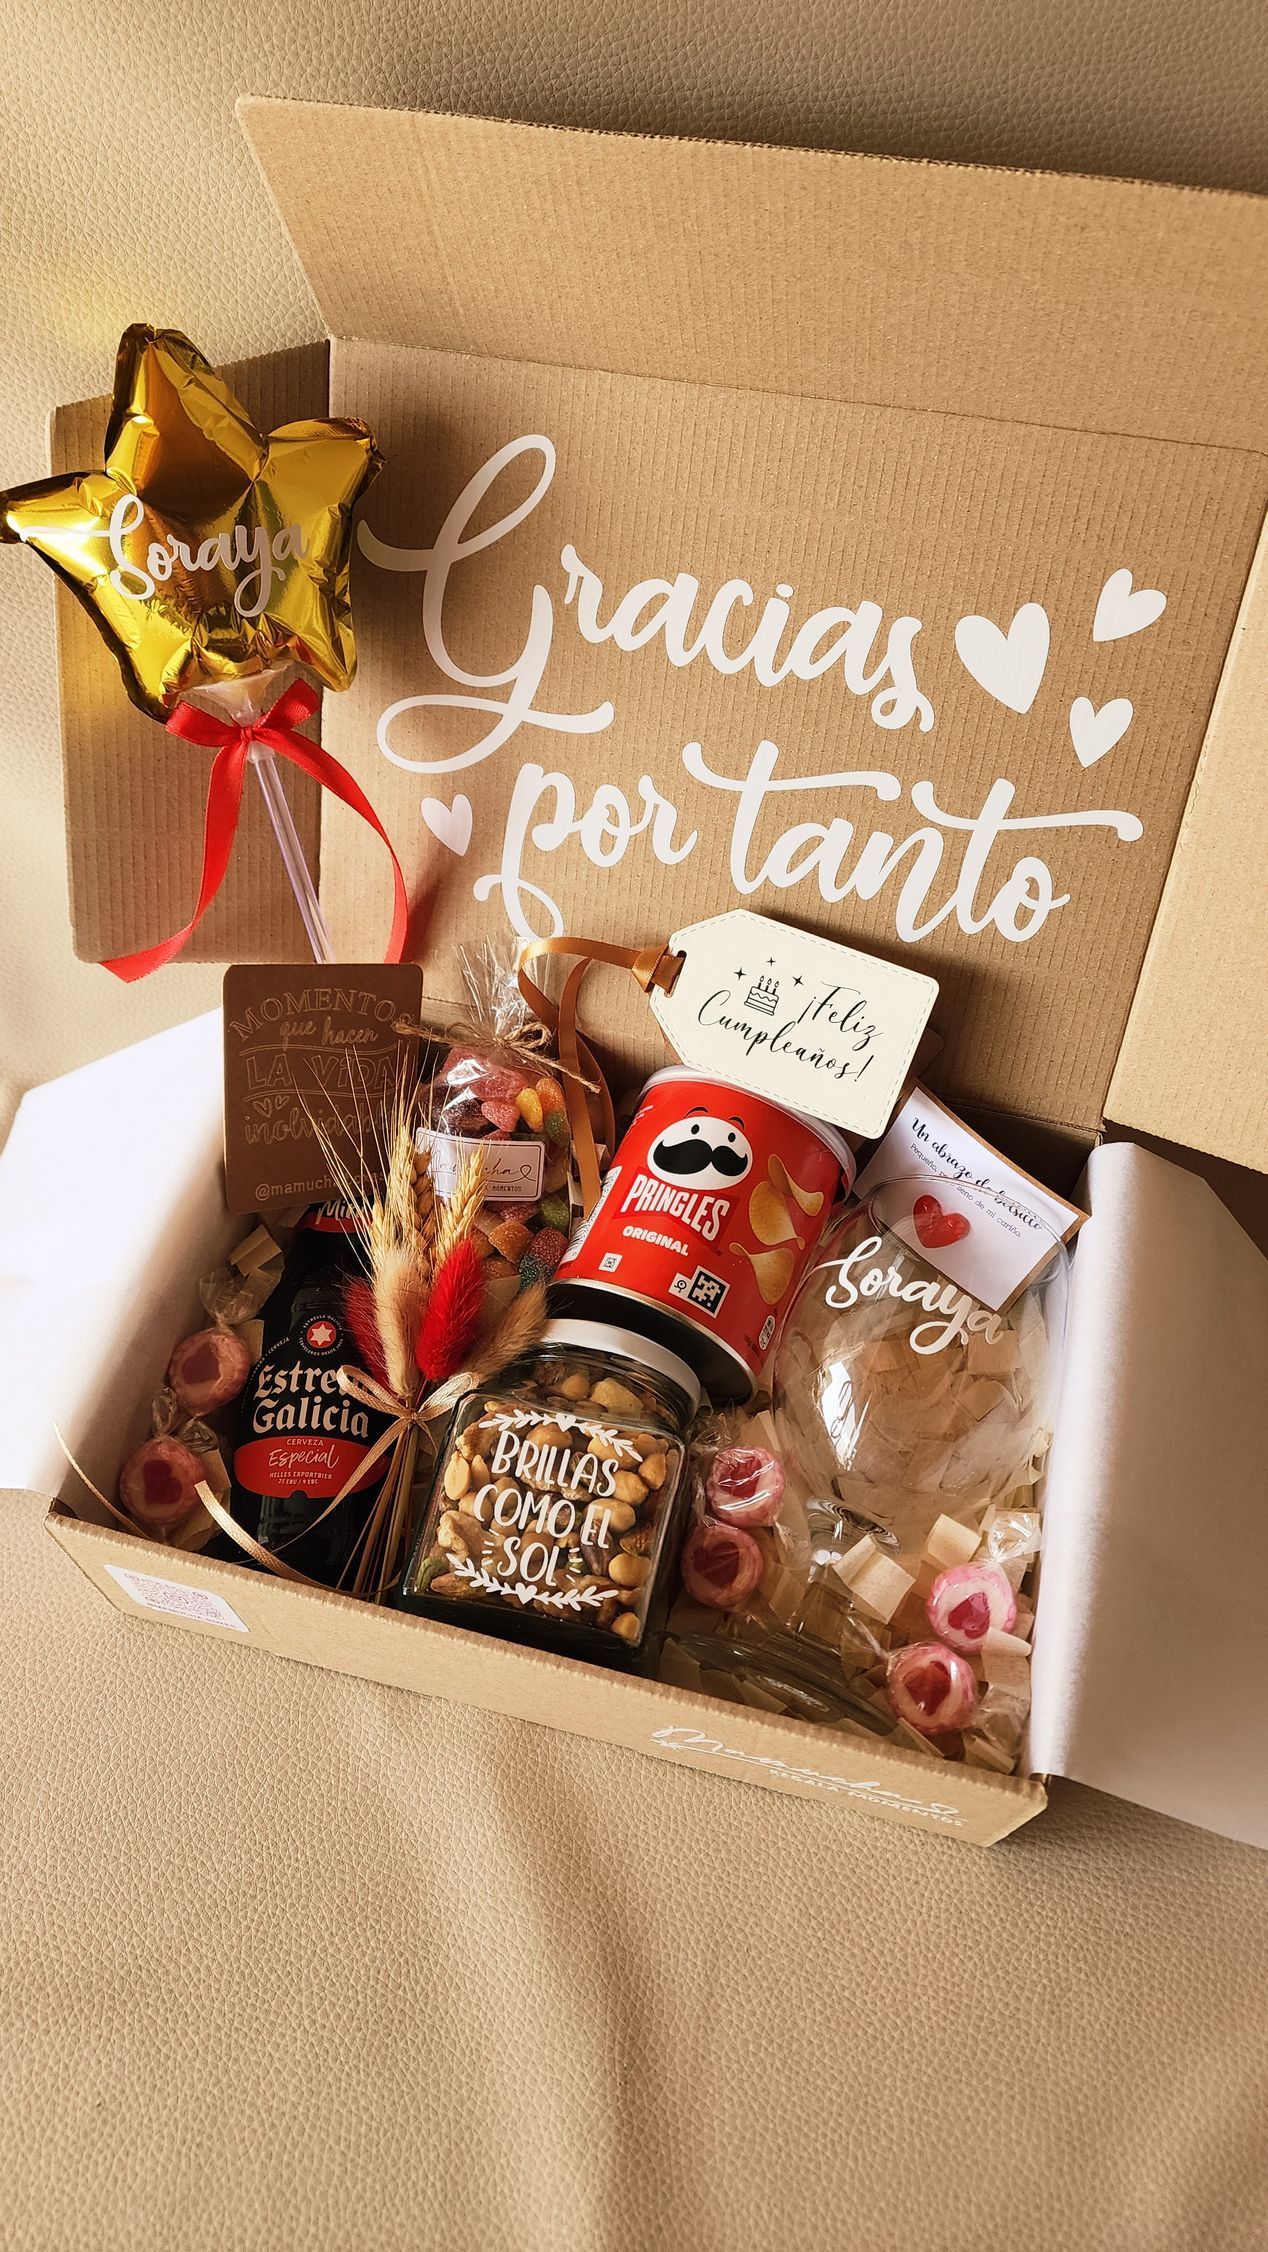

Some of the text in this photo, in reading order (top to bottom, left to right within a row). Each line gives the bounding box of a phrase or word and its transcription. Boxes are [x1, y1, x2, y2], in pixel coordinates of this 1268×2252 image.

[20, 494, 310, 618] Soraya
[356, 433, 936, 774] Gracias
[473, 740, 1145, 943] por tanto
[280, 1016, 378, 1051] que hacen
[697, 989, 875, 1082] Cumpleaños!
[797, 980, 884, 1052] ¡Feliz
[246, 1053, 293, 1090] LA
[912, 1117, 929, 1142] Un
[932, 1143, 973, 1179] abrazo
[620, 1173, 731, 1241] PRINGLES
[622, 1225, 689, 1256] ORIGINAL
[815, 1236, 1004, 1355] Soraya
[253, 1361, 368, 1400] Estre
[253, 1395, 369, 1438] Galicia
[286, 1438, 324, 1447] CERVEZA
[268, 1444, 340, 1469] Especial
[491, 1430, 618, 1497] BRILLAS
[473, 1484, 611, 1549] COMO EL
[496, 1536, 560, 1587] SOL
